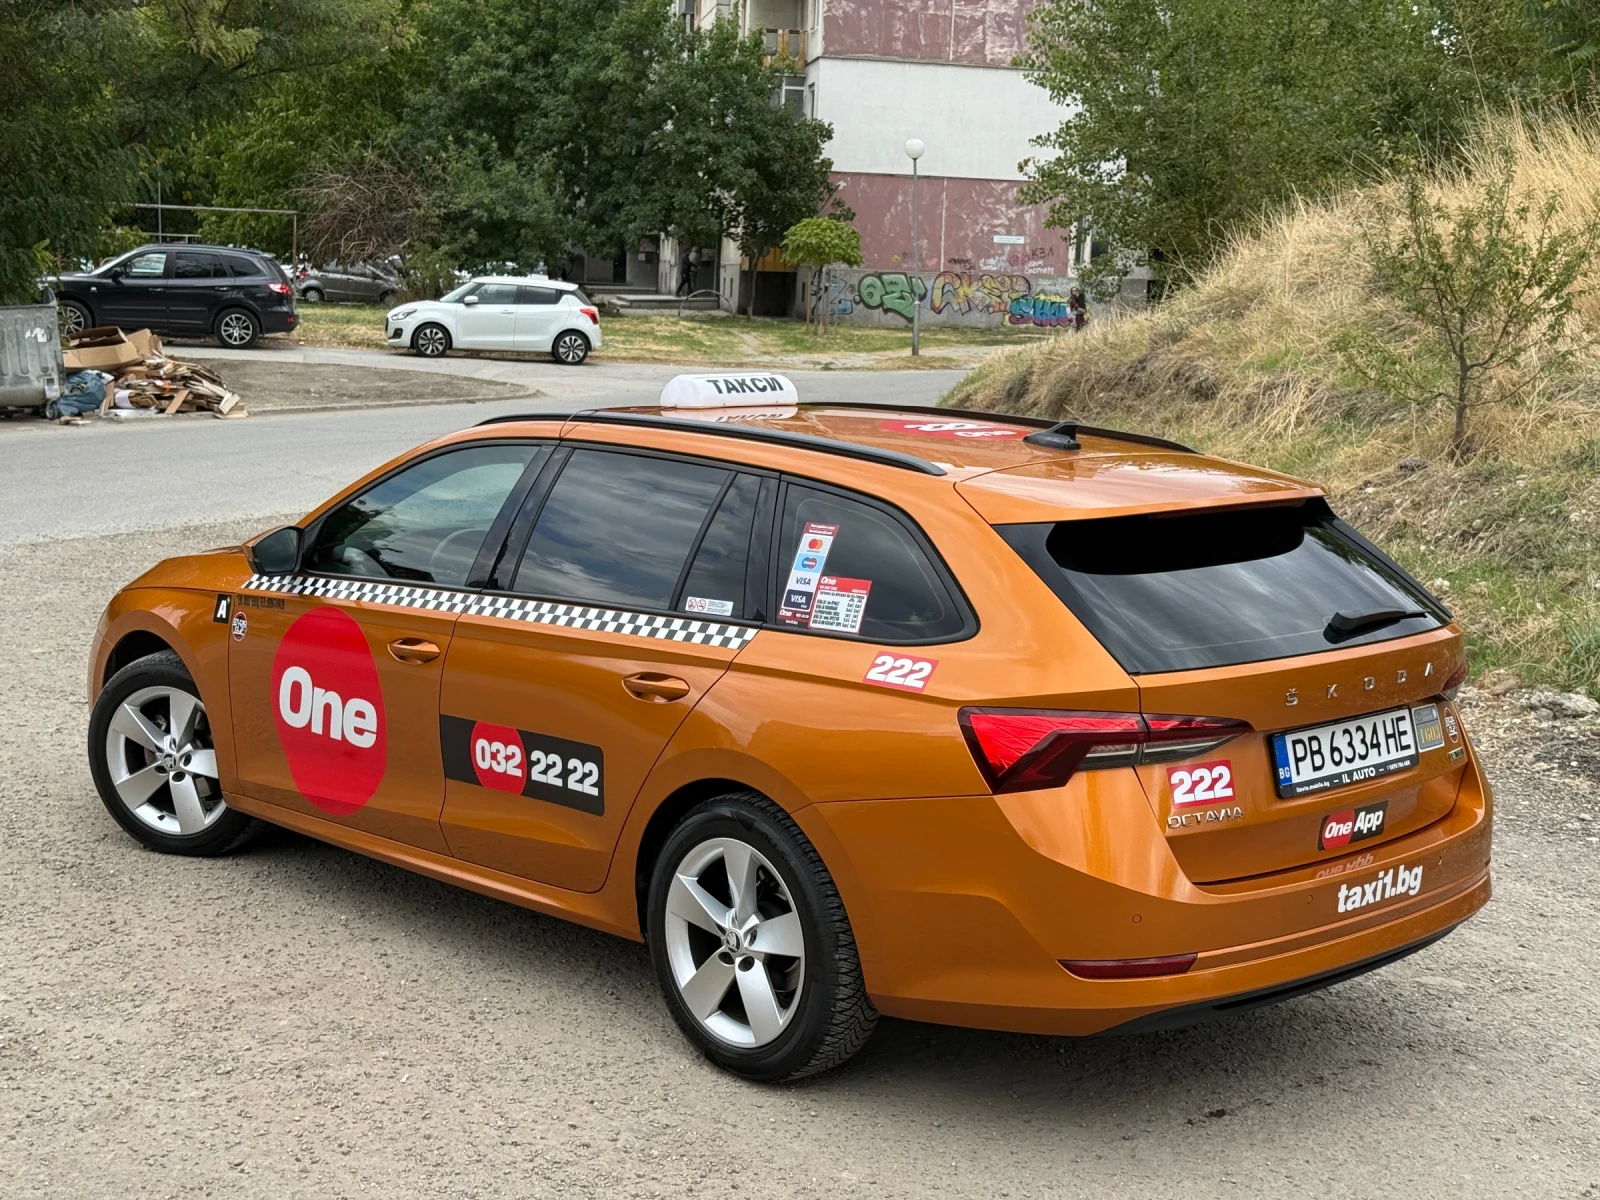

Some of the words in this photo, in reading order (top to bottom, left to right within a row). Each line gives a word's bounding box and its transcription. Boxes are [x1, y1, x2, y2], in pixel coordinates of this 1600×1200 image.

[706, 377, 784, 394] ТАКСИ
[796, 577, 811, 586] VISA
[821, 576, 837, 585] One
[790, 594, 806, 604] VISA
[779, 609, 793, 617] One
[866, 655, 932, 688] 222
[279, 666, 377, 748] One
[1292, 735, 1325, 776] PB
[1330, 722, 1381, 767] 6334
[1383, 715, 1411, 755] HE
[475, 738, 522, 777] 032
[530, 750, 562, 787] 22
[567, 758, 598, 796] 22
[1279, 767, 1291, 779] BG
[1342, 773, 1351, 783] IL
[1353, 767, 1376, 782] AUTO
[1171, 765, 1233, 804] 222
[1167, 806, 1243, 829] OCTAVIA
[1325, 819, 1352, 839] One
[1354, 809, 1383, 834] App
[1337, 864, 1424, 913] taxi1.bg
